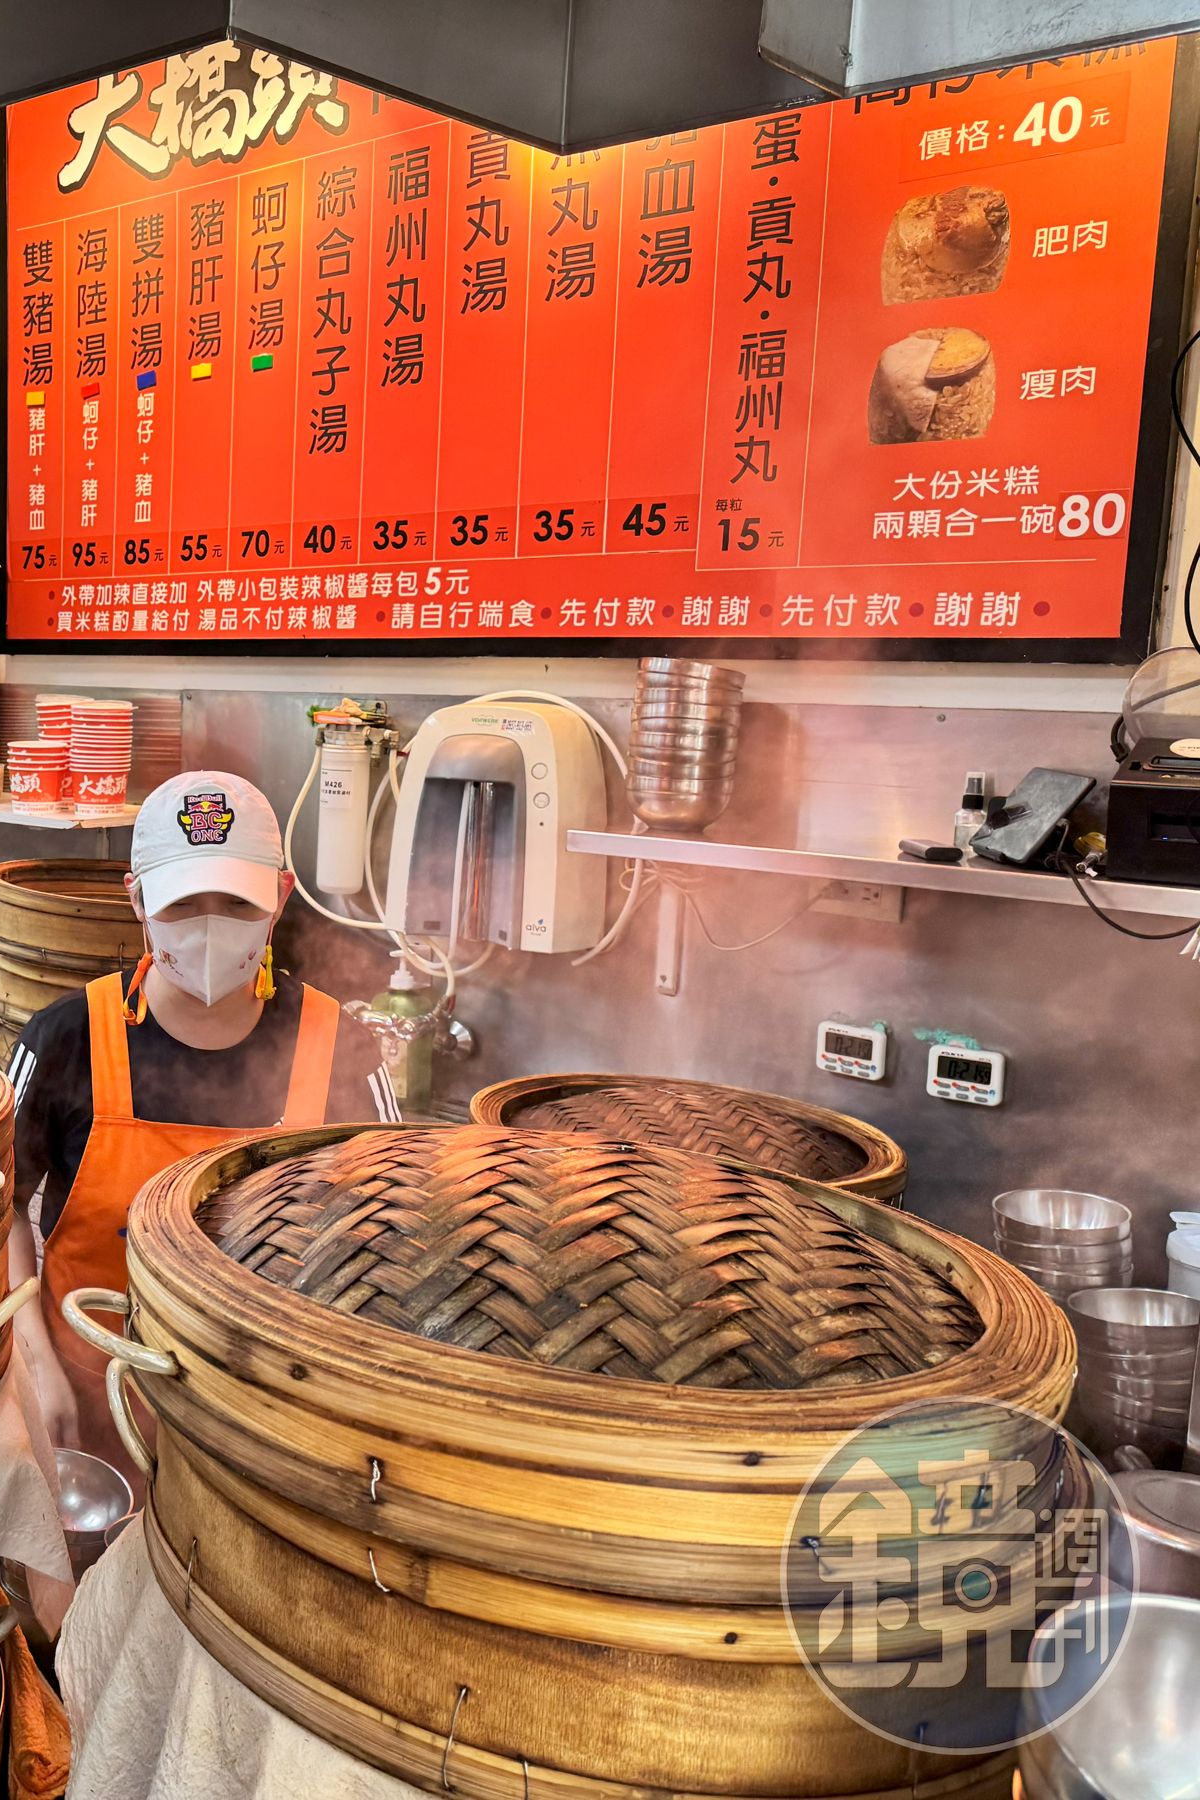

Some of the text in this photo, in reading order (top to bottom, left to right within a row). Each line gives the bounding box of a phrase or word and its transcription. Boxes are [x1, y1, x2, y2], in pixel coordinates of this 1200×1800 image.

[57, 40, 348, 191] 大橋頭
[130, 212, 164, 370] 雙拼湯
[187, 199, 225, 360] 豬肝湯
[248, 182, 289, 350] 蚵仔湯
[381, 146, 431, 387] 福州丸湯
[460, 131, 511, 314] 貢丸湯
[545, 149, 601, 302] 丸湯
[1032, 220, 1109, 259] 肥肉
[23, 239, 53, 387] 雙豬湯
[76, 228, 107, 378] 海陸湯
[308, 165, 357, 455] 綜合丸子湯
[1020, 365, 1098, 402] 瘦肉
[715, 498, 743, 512] 每粒
[892, 465, 1040, 501] 大份米糕
[56, 591, 1021, 633] 買米糕酌量給付 湯品不付辣椒醬 請自行端食 先付款 謝謝 先付款 謝謝
[61, 581, 188, 606] 外帶加辣直接加
[190, 811, 222, 830] BC
[191, 829, 224, 843] ONE
